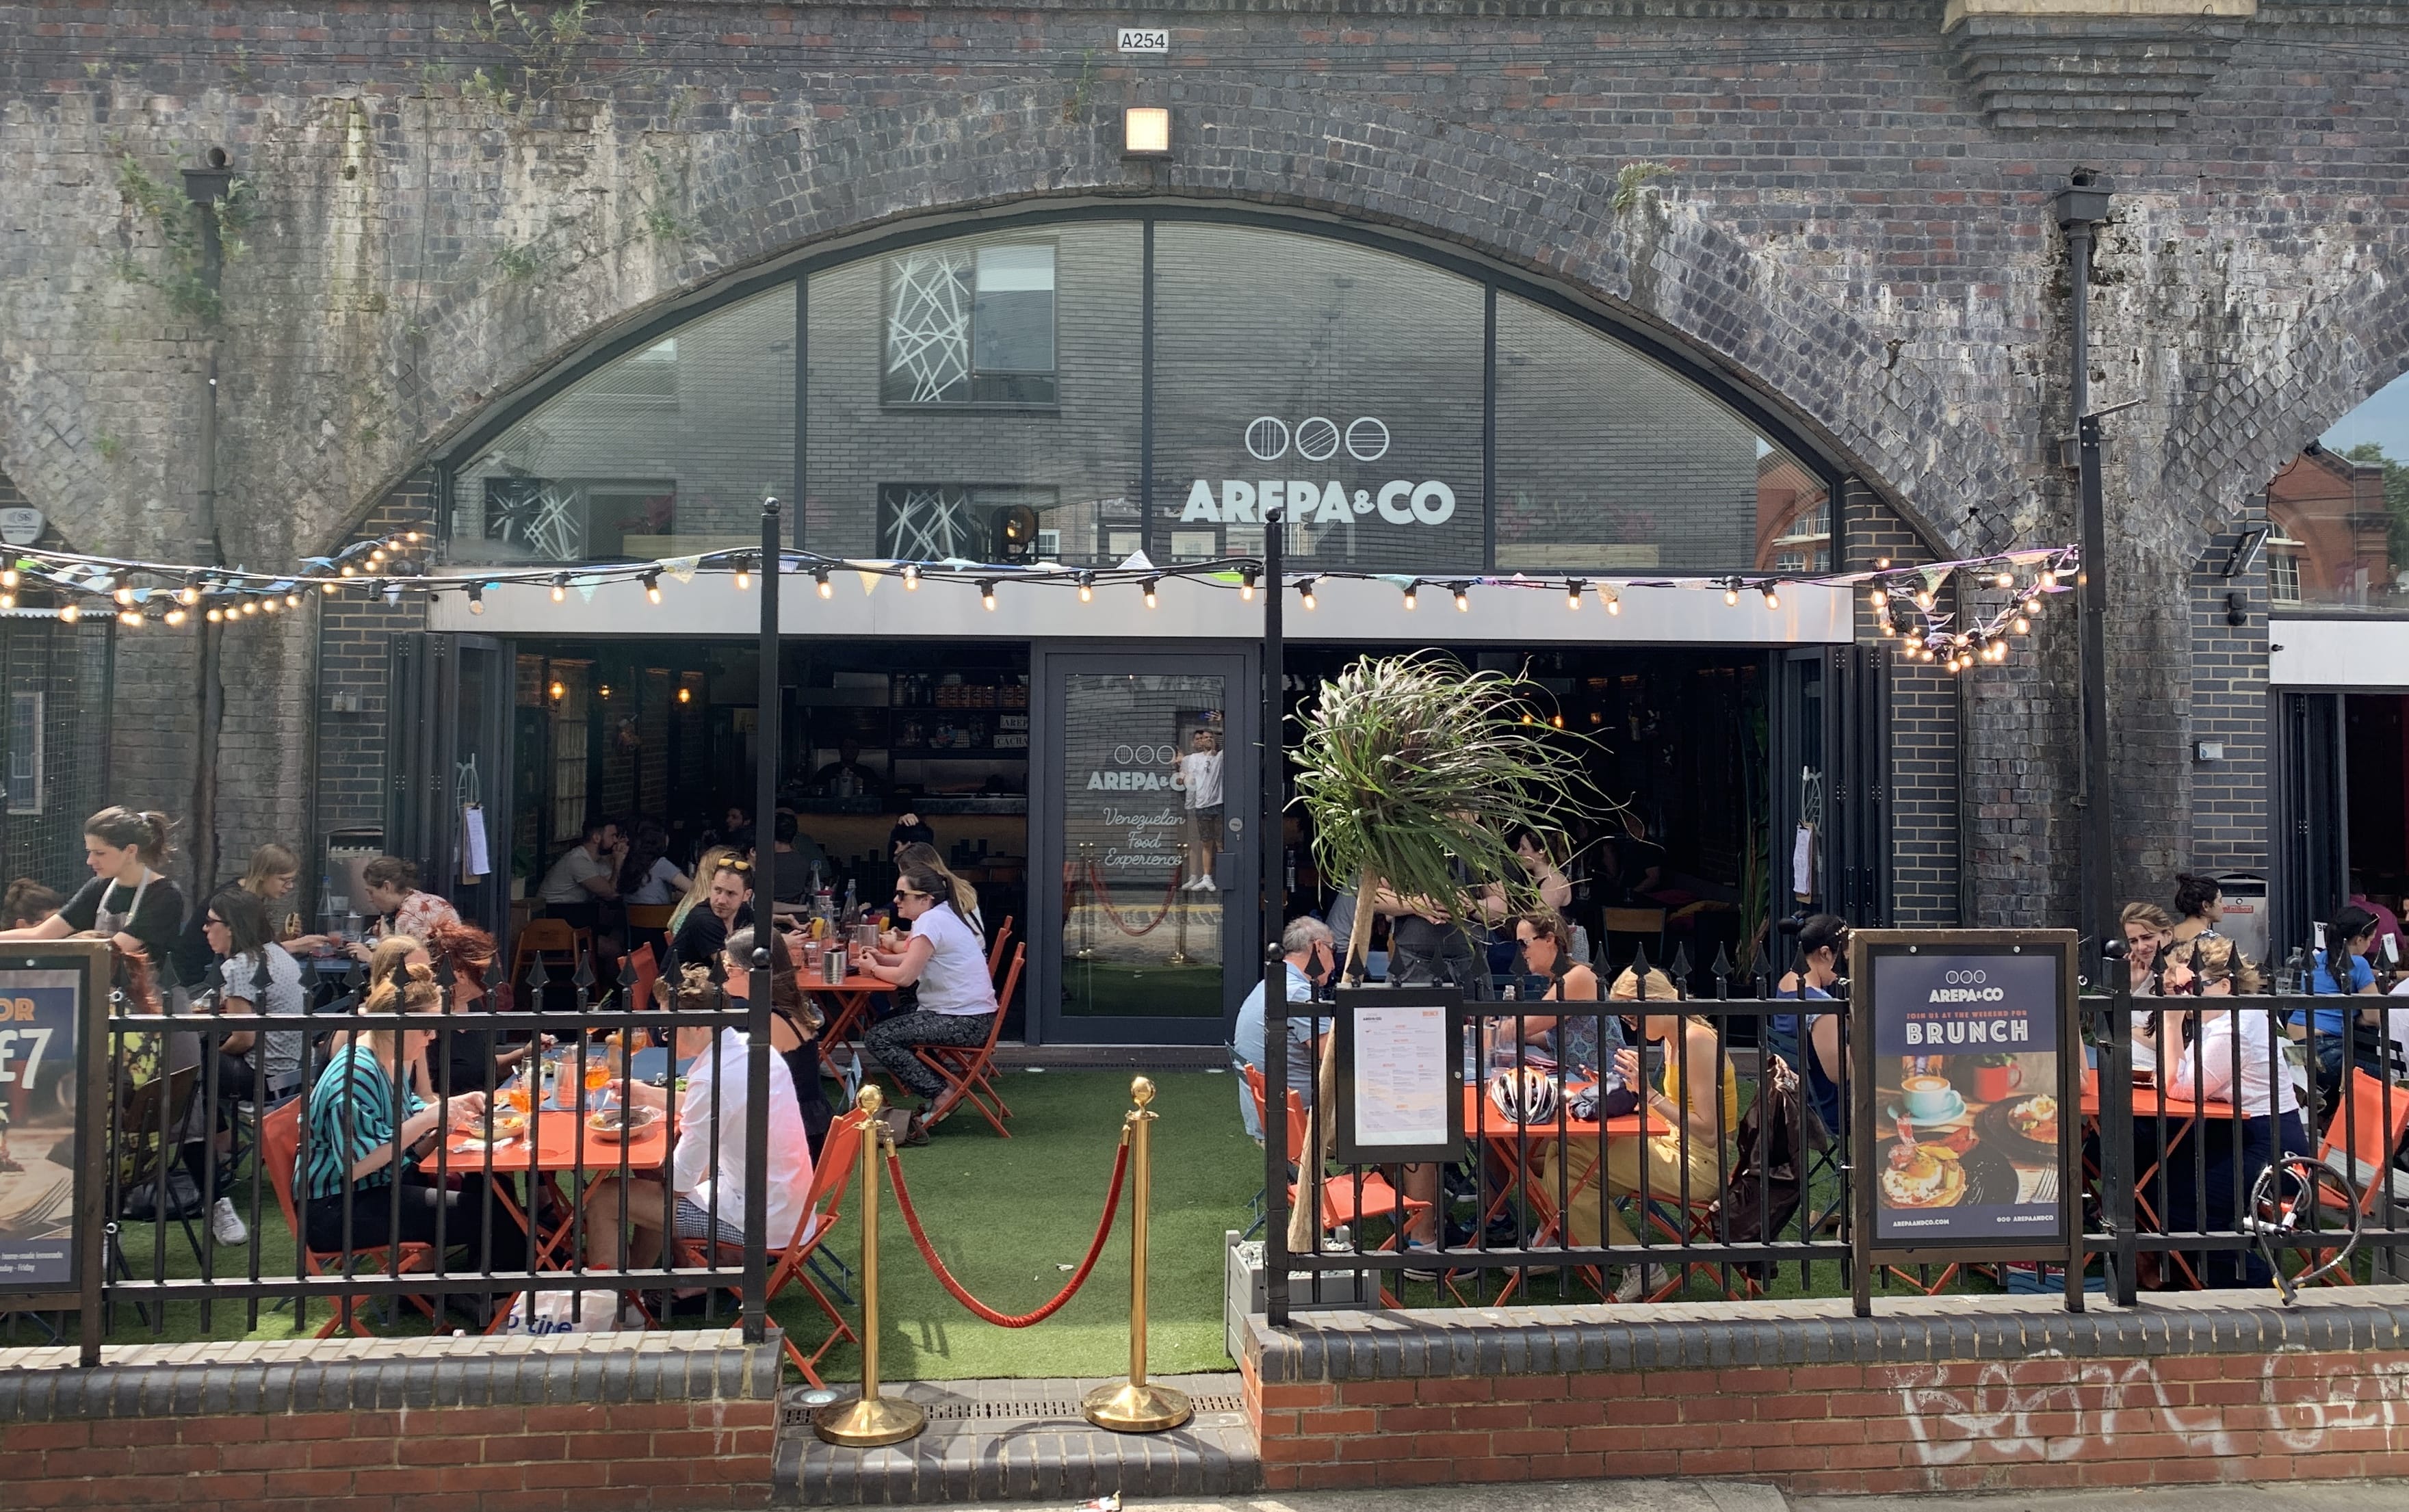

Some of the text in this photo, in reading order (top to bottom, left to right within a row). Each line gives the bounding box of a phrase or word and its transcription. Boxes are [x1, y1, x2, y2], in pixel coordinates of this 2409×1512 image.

[1121, 32, 1166, 49] A254
[1180, 479, 1456, 525] AREPA&CO
[1086, 771, 1202, 792] AREPA&CO
[1103, 807, 1186, 830] Venezuelan
[1128, 831, 1162, 849] Food
[1104, 847, 1184, 870] Experience
[1929, 987, 2004, 1002] AREPA&CO
[1972, 1010, 2009, 1018] WEEKEND
[1906, 1019, 2029, 1045] BRUNCH
[0, 1028, 53, 1089] £7
